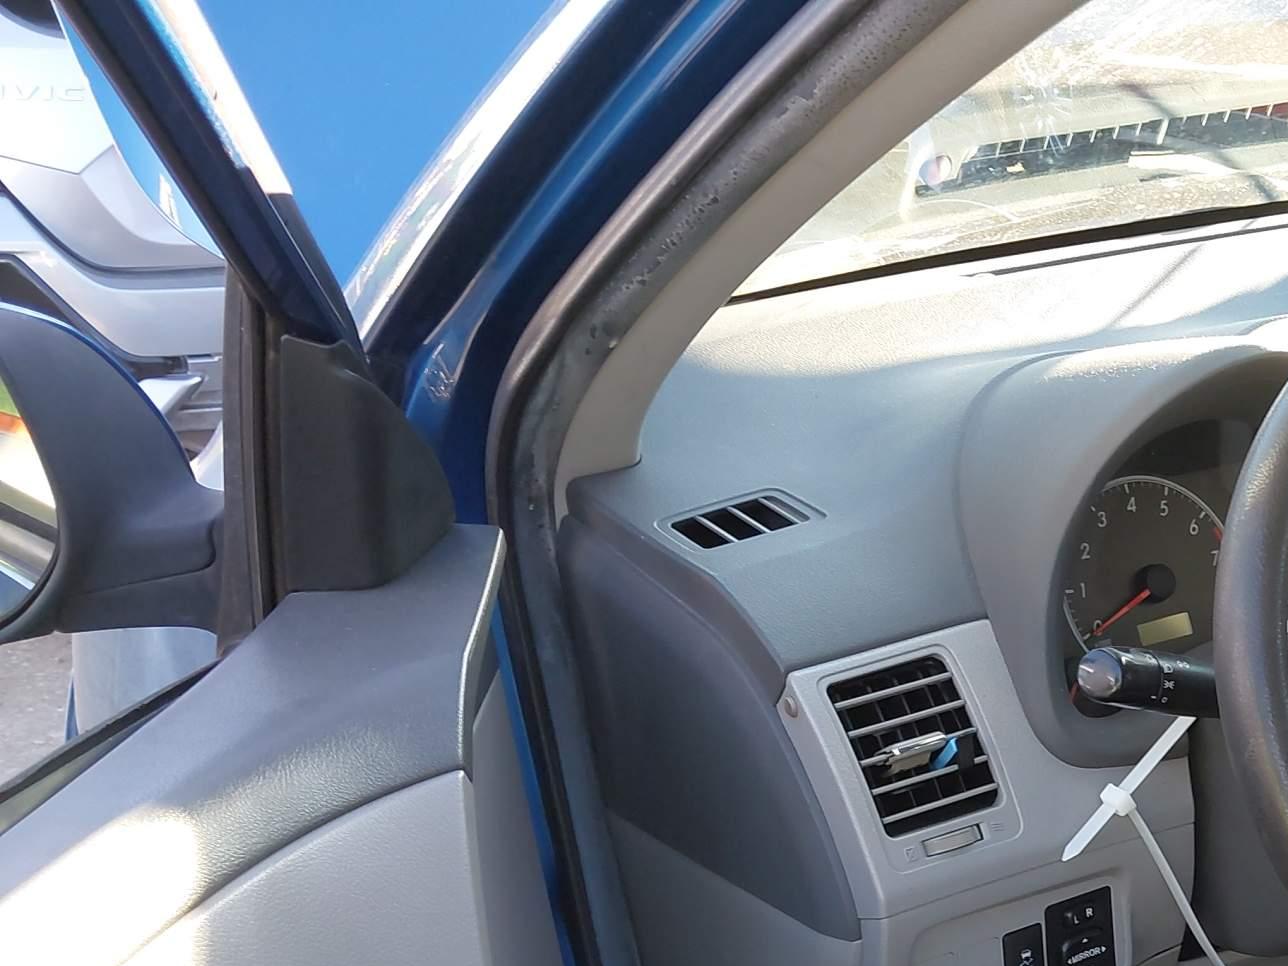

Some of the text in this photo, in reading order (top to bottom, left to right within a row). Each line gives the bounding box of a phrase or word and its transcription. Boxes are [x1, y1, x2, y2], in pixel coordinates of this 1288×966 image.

[1126, 496, 1137, 513] 4
[1159, 500, 1169, 516] 5
[1096, 511, 1108, 528] 3
[1189, 518, 1200, 535] 6
[1079, 543, 1091, 560] 2
[1079, 583, 1087, 598] 1
[1073, 907, 1094, 925] L R
[1071, 946, 1102, 964] MIRROR
